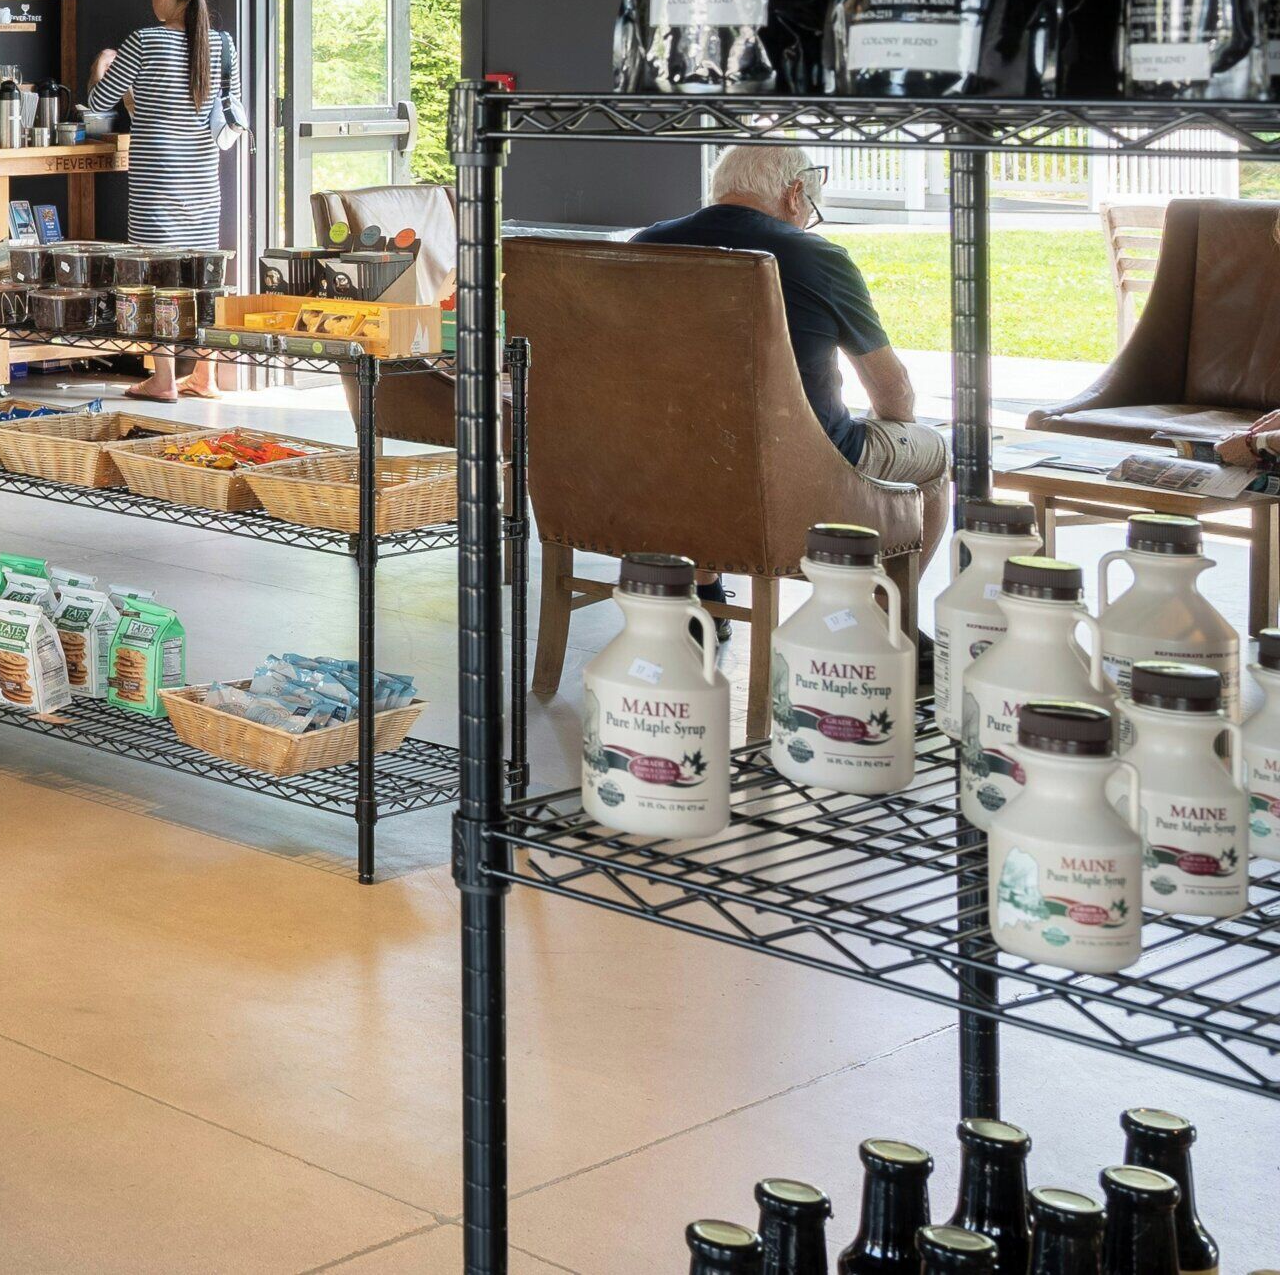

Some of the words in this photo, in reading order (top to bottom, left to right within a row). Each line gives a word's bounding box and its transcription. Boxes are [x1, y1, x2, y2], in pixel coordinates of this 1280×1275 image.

[861, 37, 899, 47] COLONY
[902, 37, 938, 47] BLEND
[966, 623, 1007, 633] REFRIGERAT
[810, 660, 876, 681] MAINE
[795, 674, 819, 690] Pure
[821, 679, 858, 698] Maple
[861, 683, 892, 699] Syrup
[622, 697, 690, 719] MAINE
[606, 712, 630, 728] Pure
[634, 717, 670, 737] Maple
[674, 723, 706, 739] Syrup
[987, 715, 1013, 733] Pure
[1171, 804, 1227, 821] MAINE
[1156, 817, 1178, 831] Pure
[1182, 821, 1211, 836] Maple
[1214, 824, 1236, 837] Syrup
[1062, 857, 1117, 873] MAINE
[1047, 869, 1068, 883] Pure
[1072, 872, 1101, 888] Maple
[1104, 875, 1127, 890] Syrup
